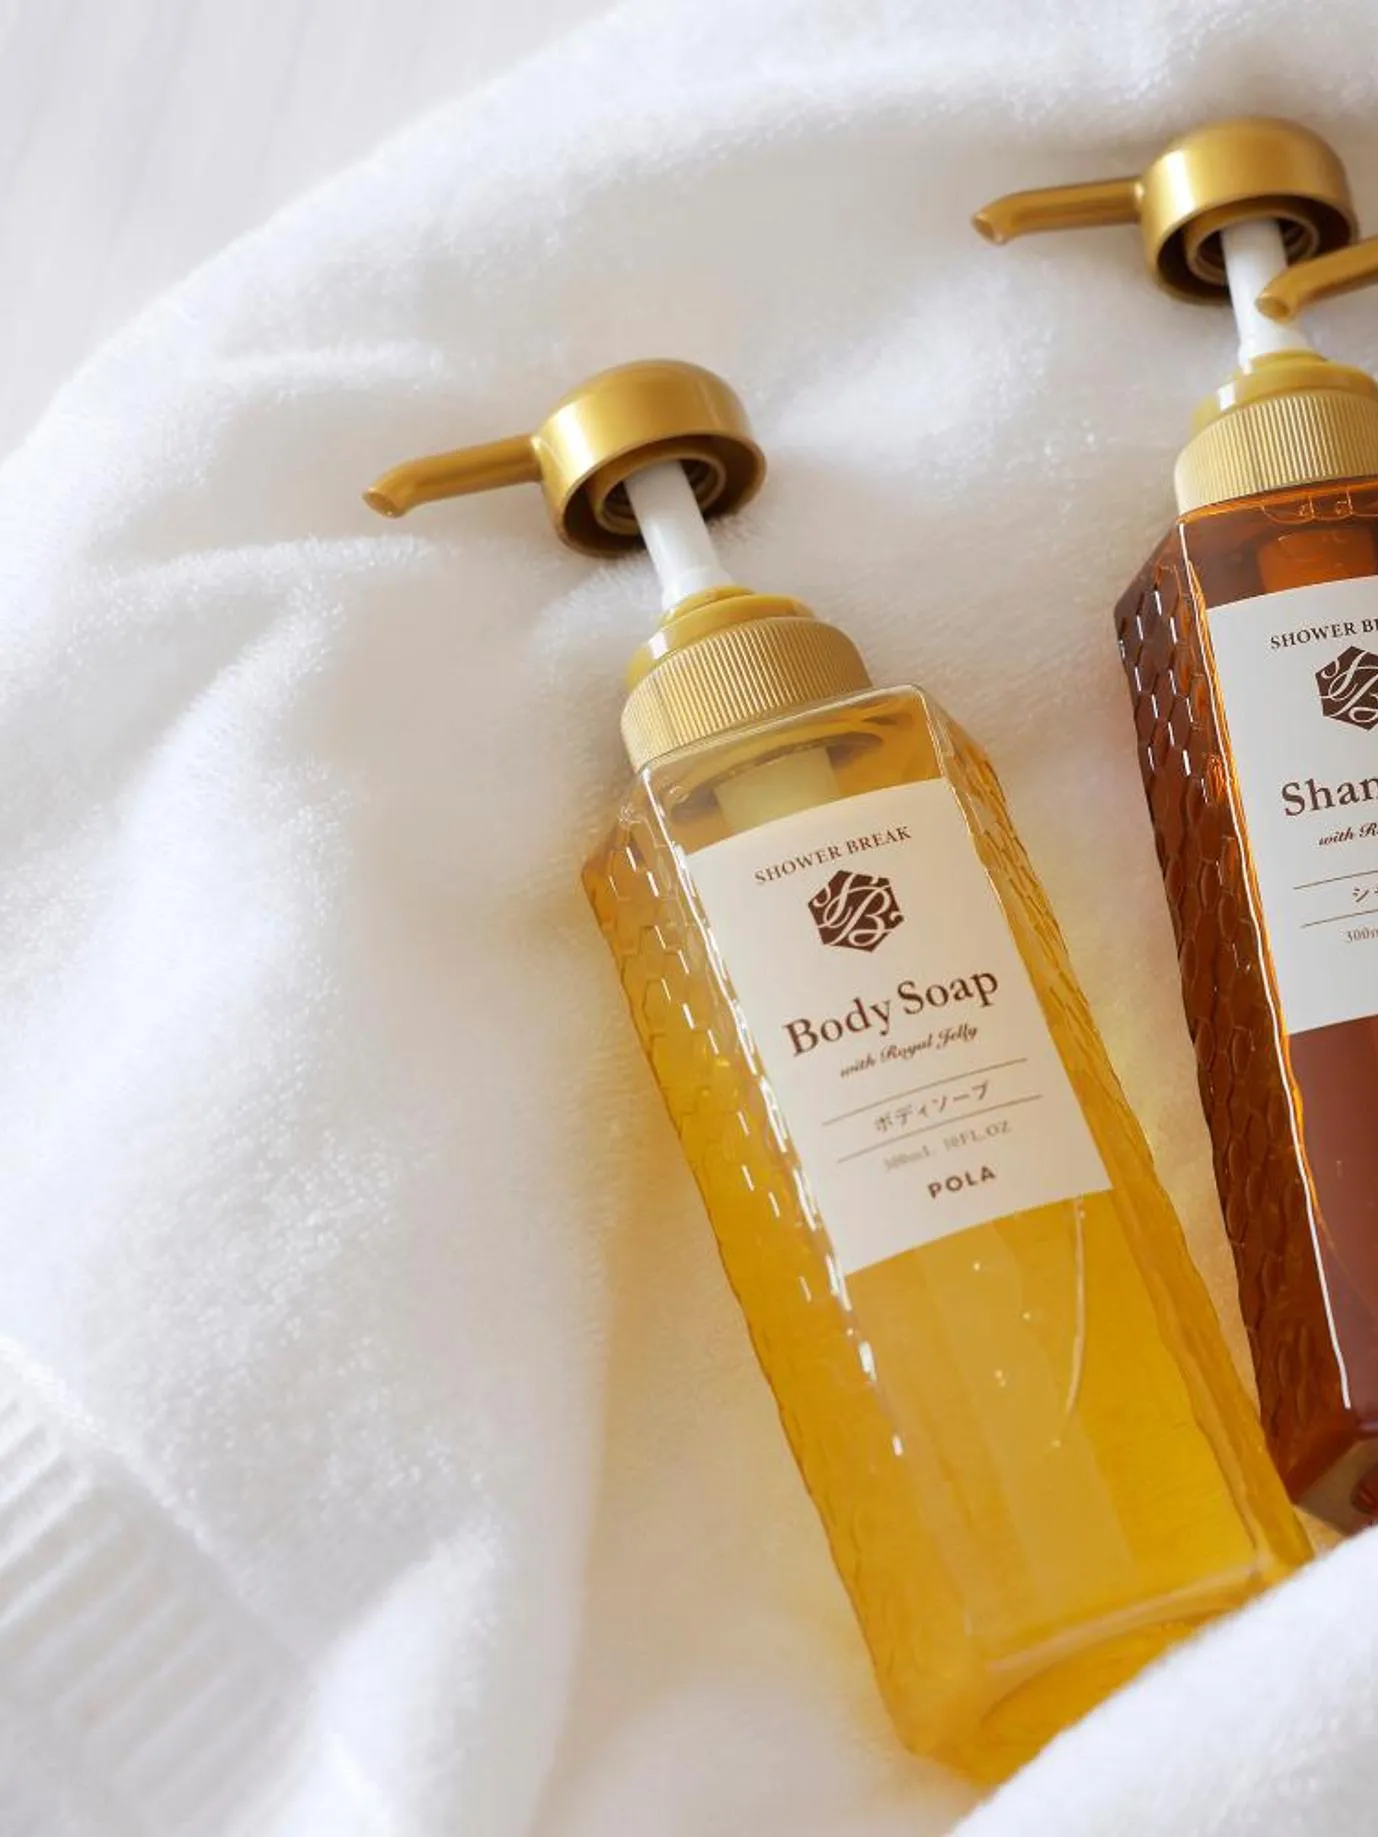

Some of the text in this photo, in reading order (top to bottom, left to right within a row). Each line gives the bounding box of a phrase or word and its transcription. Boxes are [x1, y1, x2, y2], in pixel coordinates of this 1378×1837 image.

[1270, 621, 1357, 650] SHOWER
[754, 825, 912, 886] SHOWER BREAK
[1318, 828, 1355, 847] with
[783, 970, 999, 1057] Body Soap
[840, 1024, 979, 1079] with Royal Jelly
[927, 1165, 996, 1199] POLA
